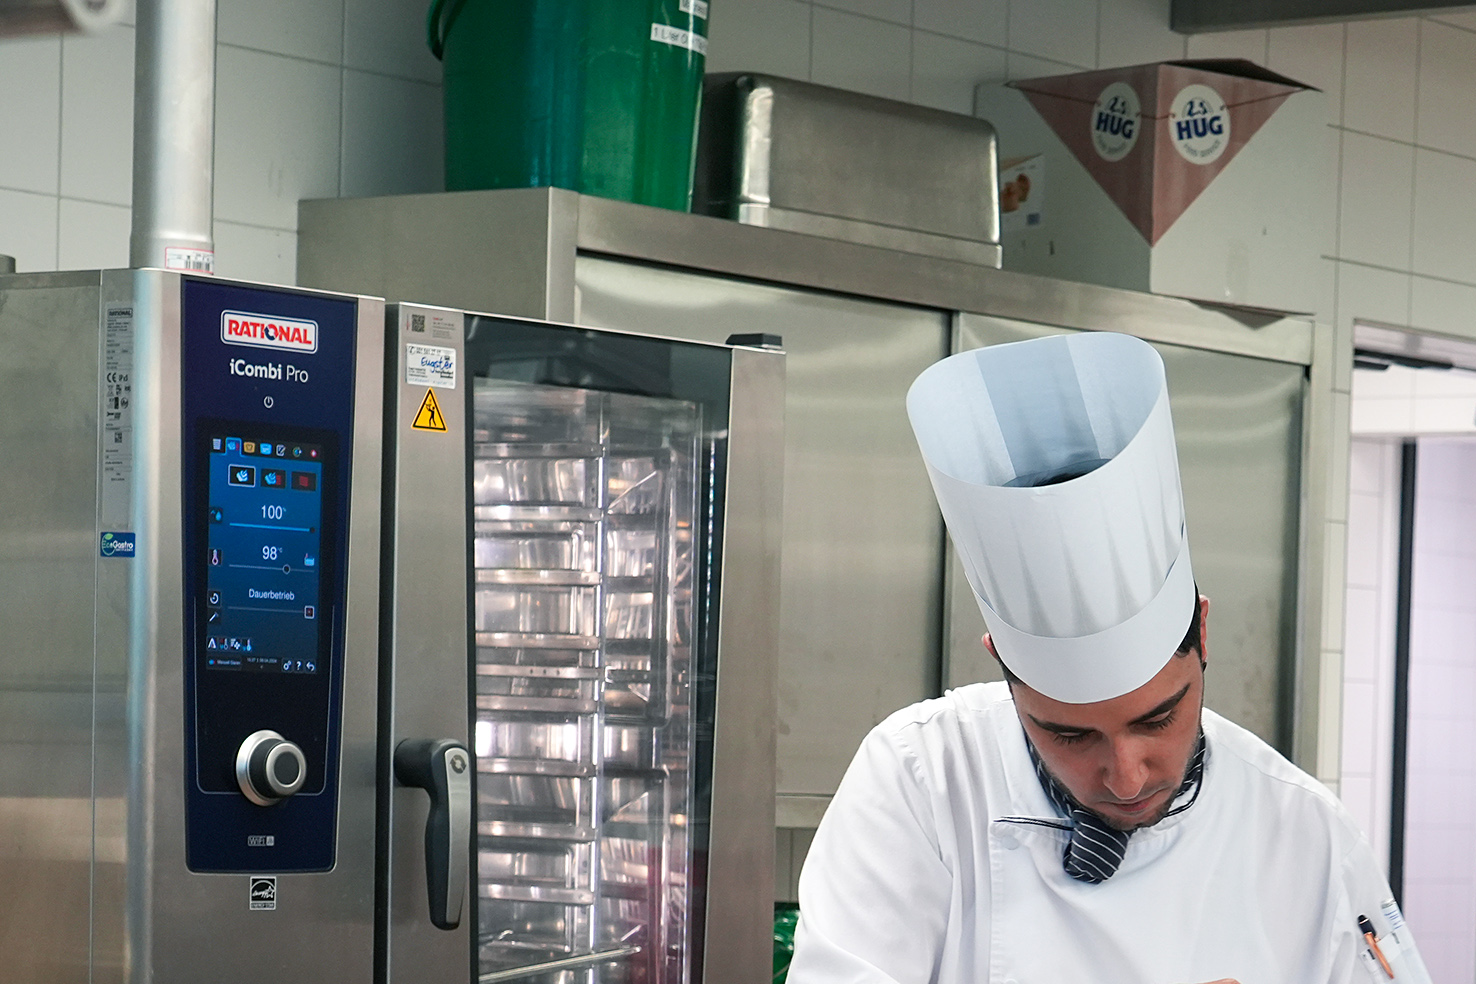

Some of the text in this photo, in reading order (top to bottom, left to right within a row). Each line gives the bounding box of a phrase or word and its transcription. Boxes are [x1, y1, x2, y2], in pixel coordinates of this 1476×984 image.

[1096, 112, 1134, 139] HUG
[1175, 115, 1223, 140] HUG
[228, 319, 312, 344] RATIONAL
[230, 358, 309, 383] iCombi Pro
[248, 588, 295, 601] Dauerbetrieb
